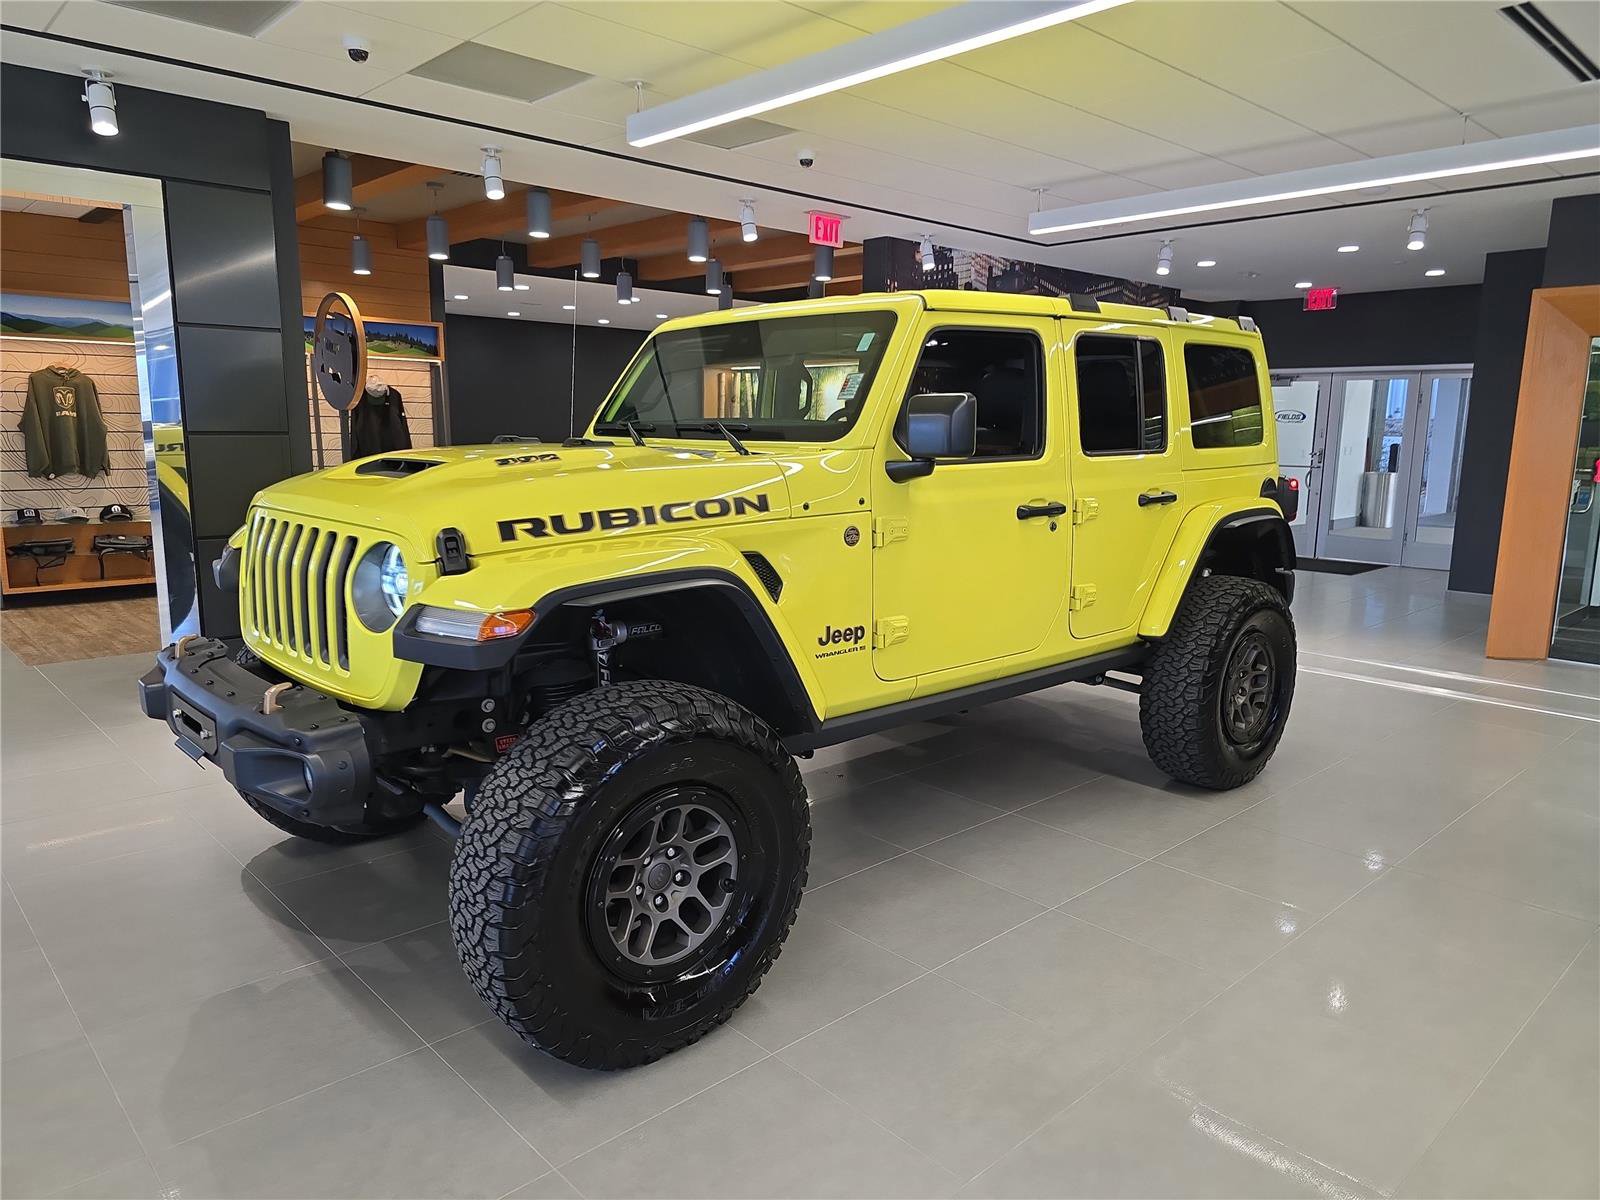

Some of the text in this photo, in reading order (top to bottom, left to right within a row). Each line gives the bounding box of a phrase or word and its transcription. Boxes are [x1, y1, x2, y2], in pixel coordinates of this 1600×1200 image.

[815, 216, 841, 243] EXIT
[496, 494, 770, 543] RUBICON
[818, 625, 865, 646] Jeep
[815, 646, 858, 659] WRANGLER
